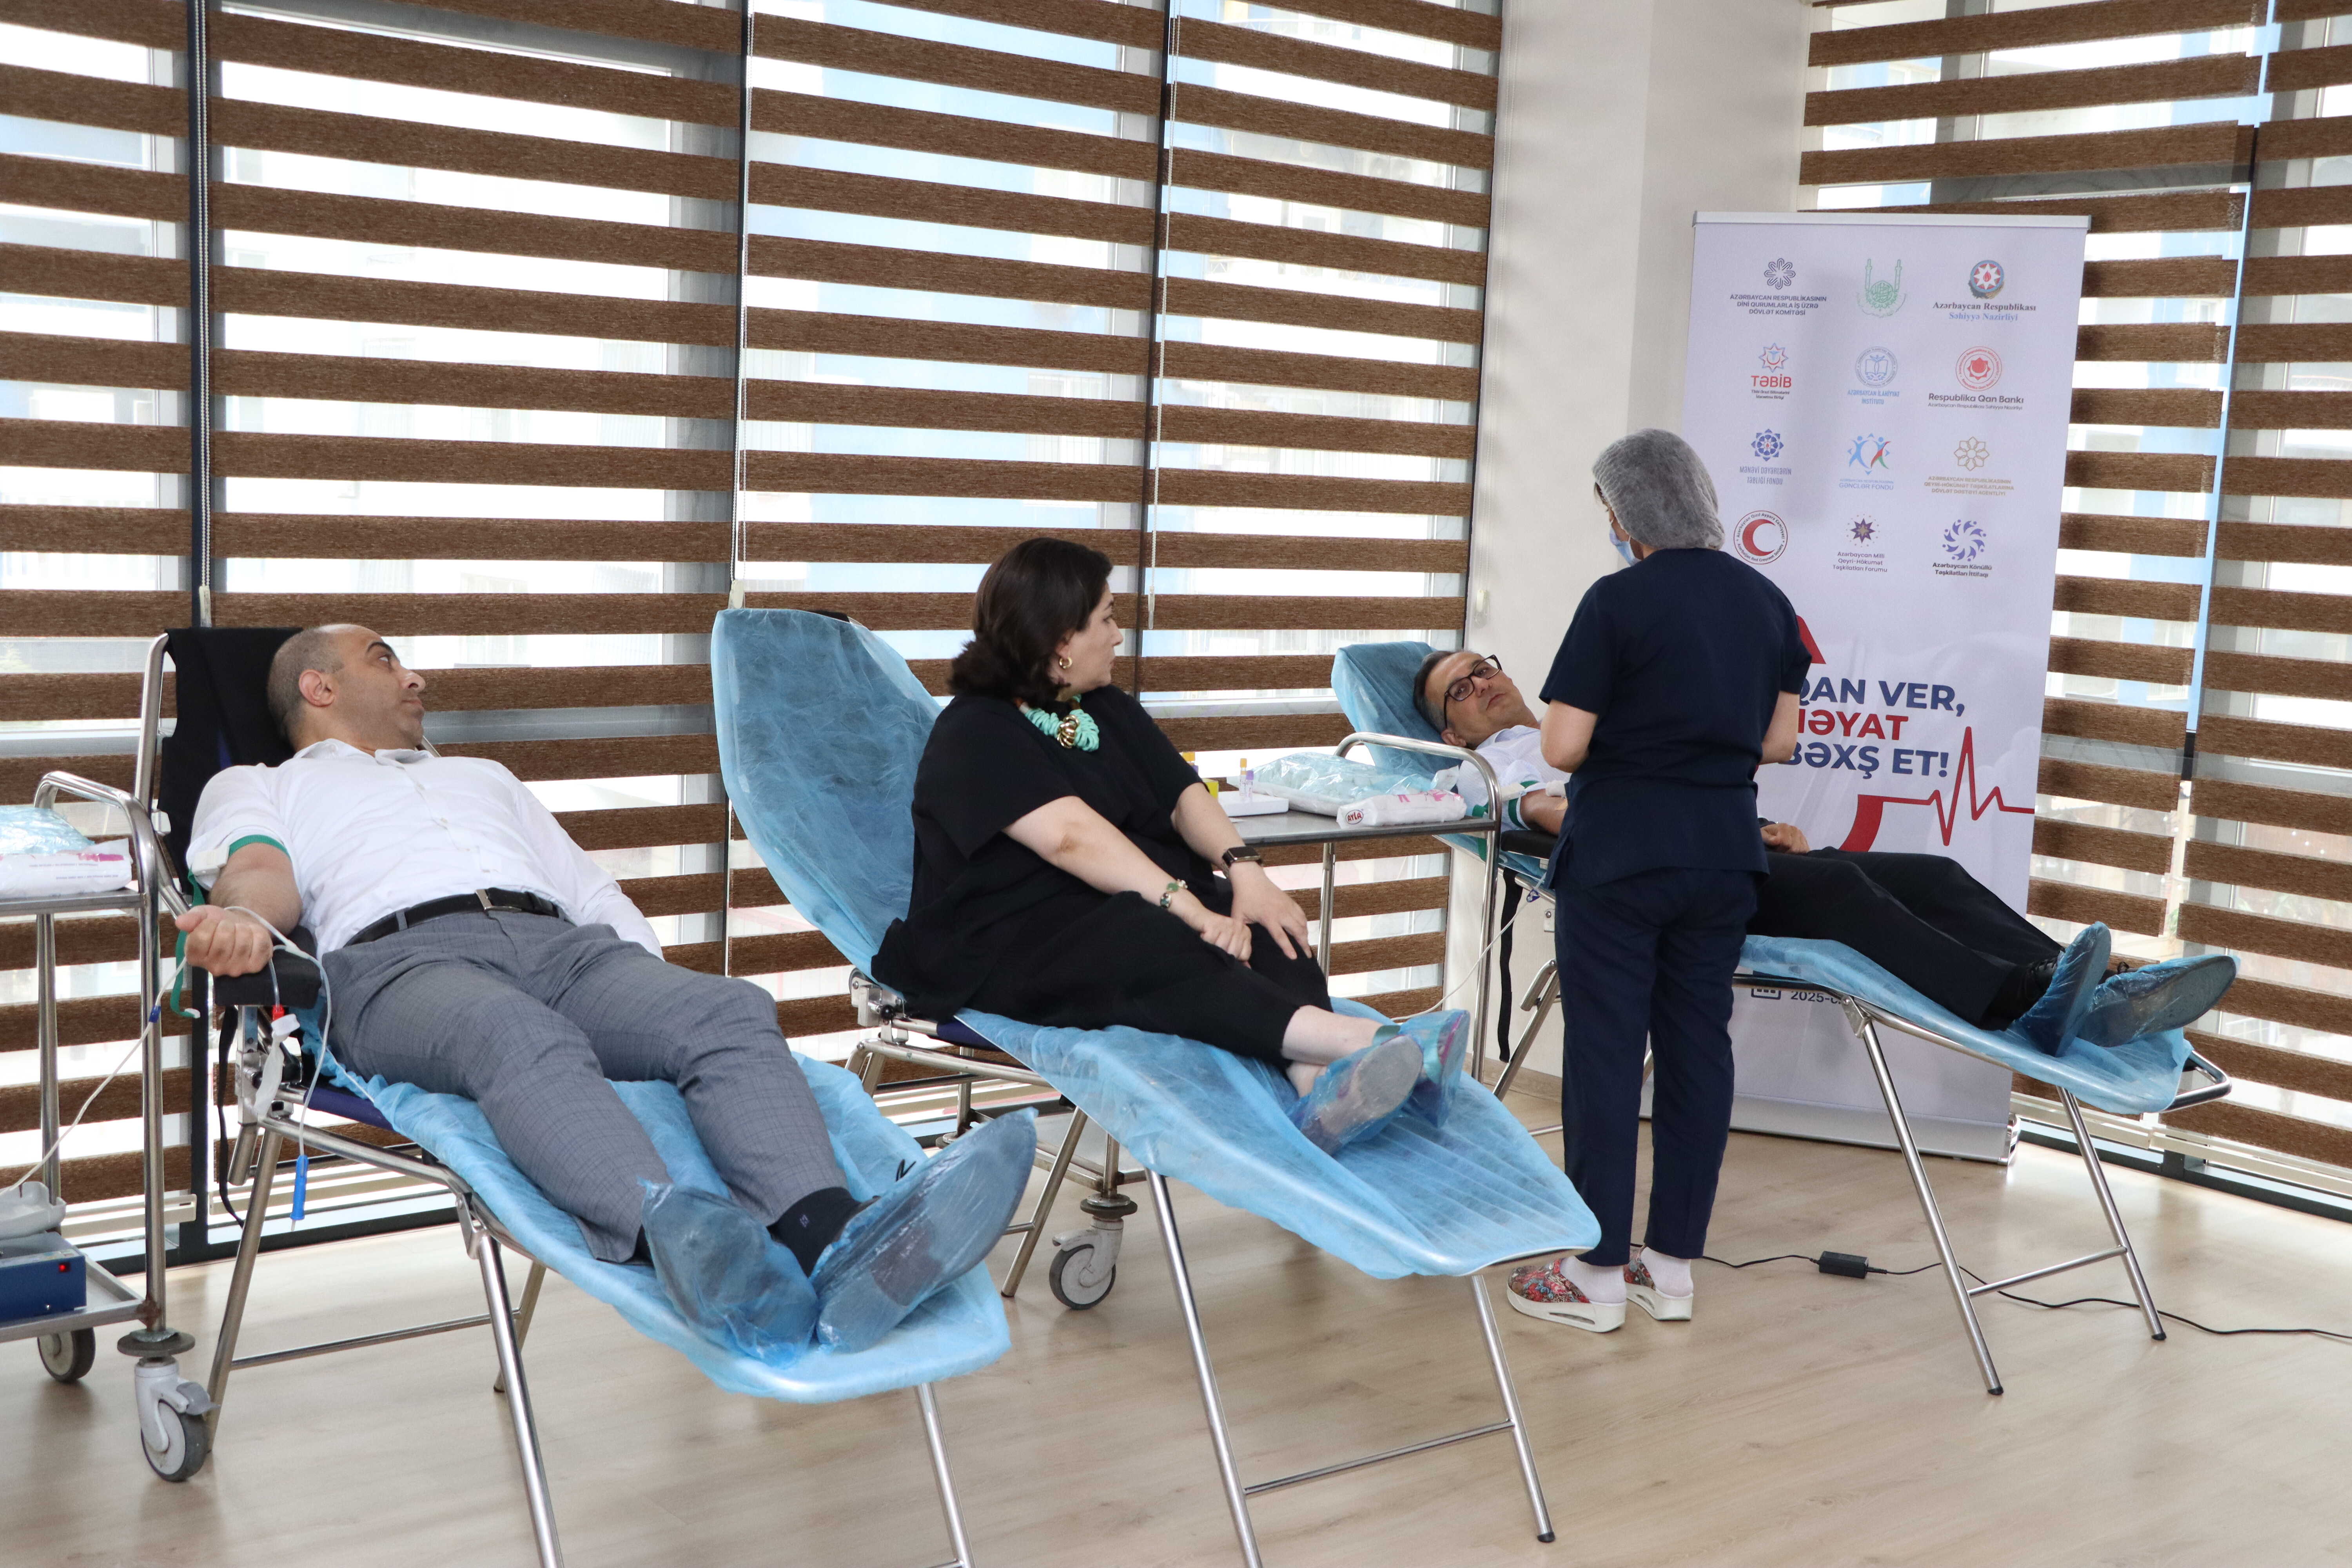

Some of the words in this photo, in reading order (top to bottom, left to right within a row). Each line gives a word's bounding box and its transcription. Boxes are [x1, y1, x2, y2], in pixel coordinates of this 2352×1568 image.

[1933, 302, 1981, 311] Azərbaycan
[1984, 303, 2036, 312] Respublikası
[1949, 312, 1980, 322] Səhiyyə
[1751, 374, 1792, 388] TƏBİB
[1929, 393, 1976, 402] Respublika
[1878, 681, 1965, 717] VER,
[1798, 708, 1909, 740] ƏYAT
[1892, 748, 1949, 777] ET!
[1348, 812, 1362, 822] AYLA
